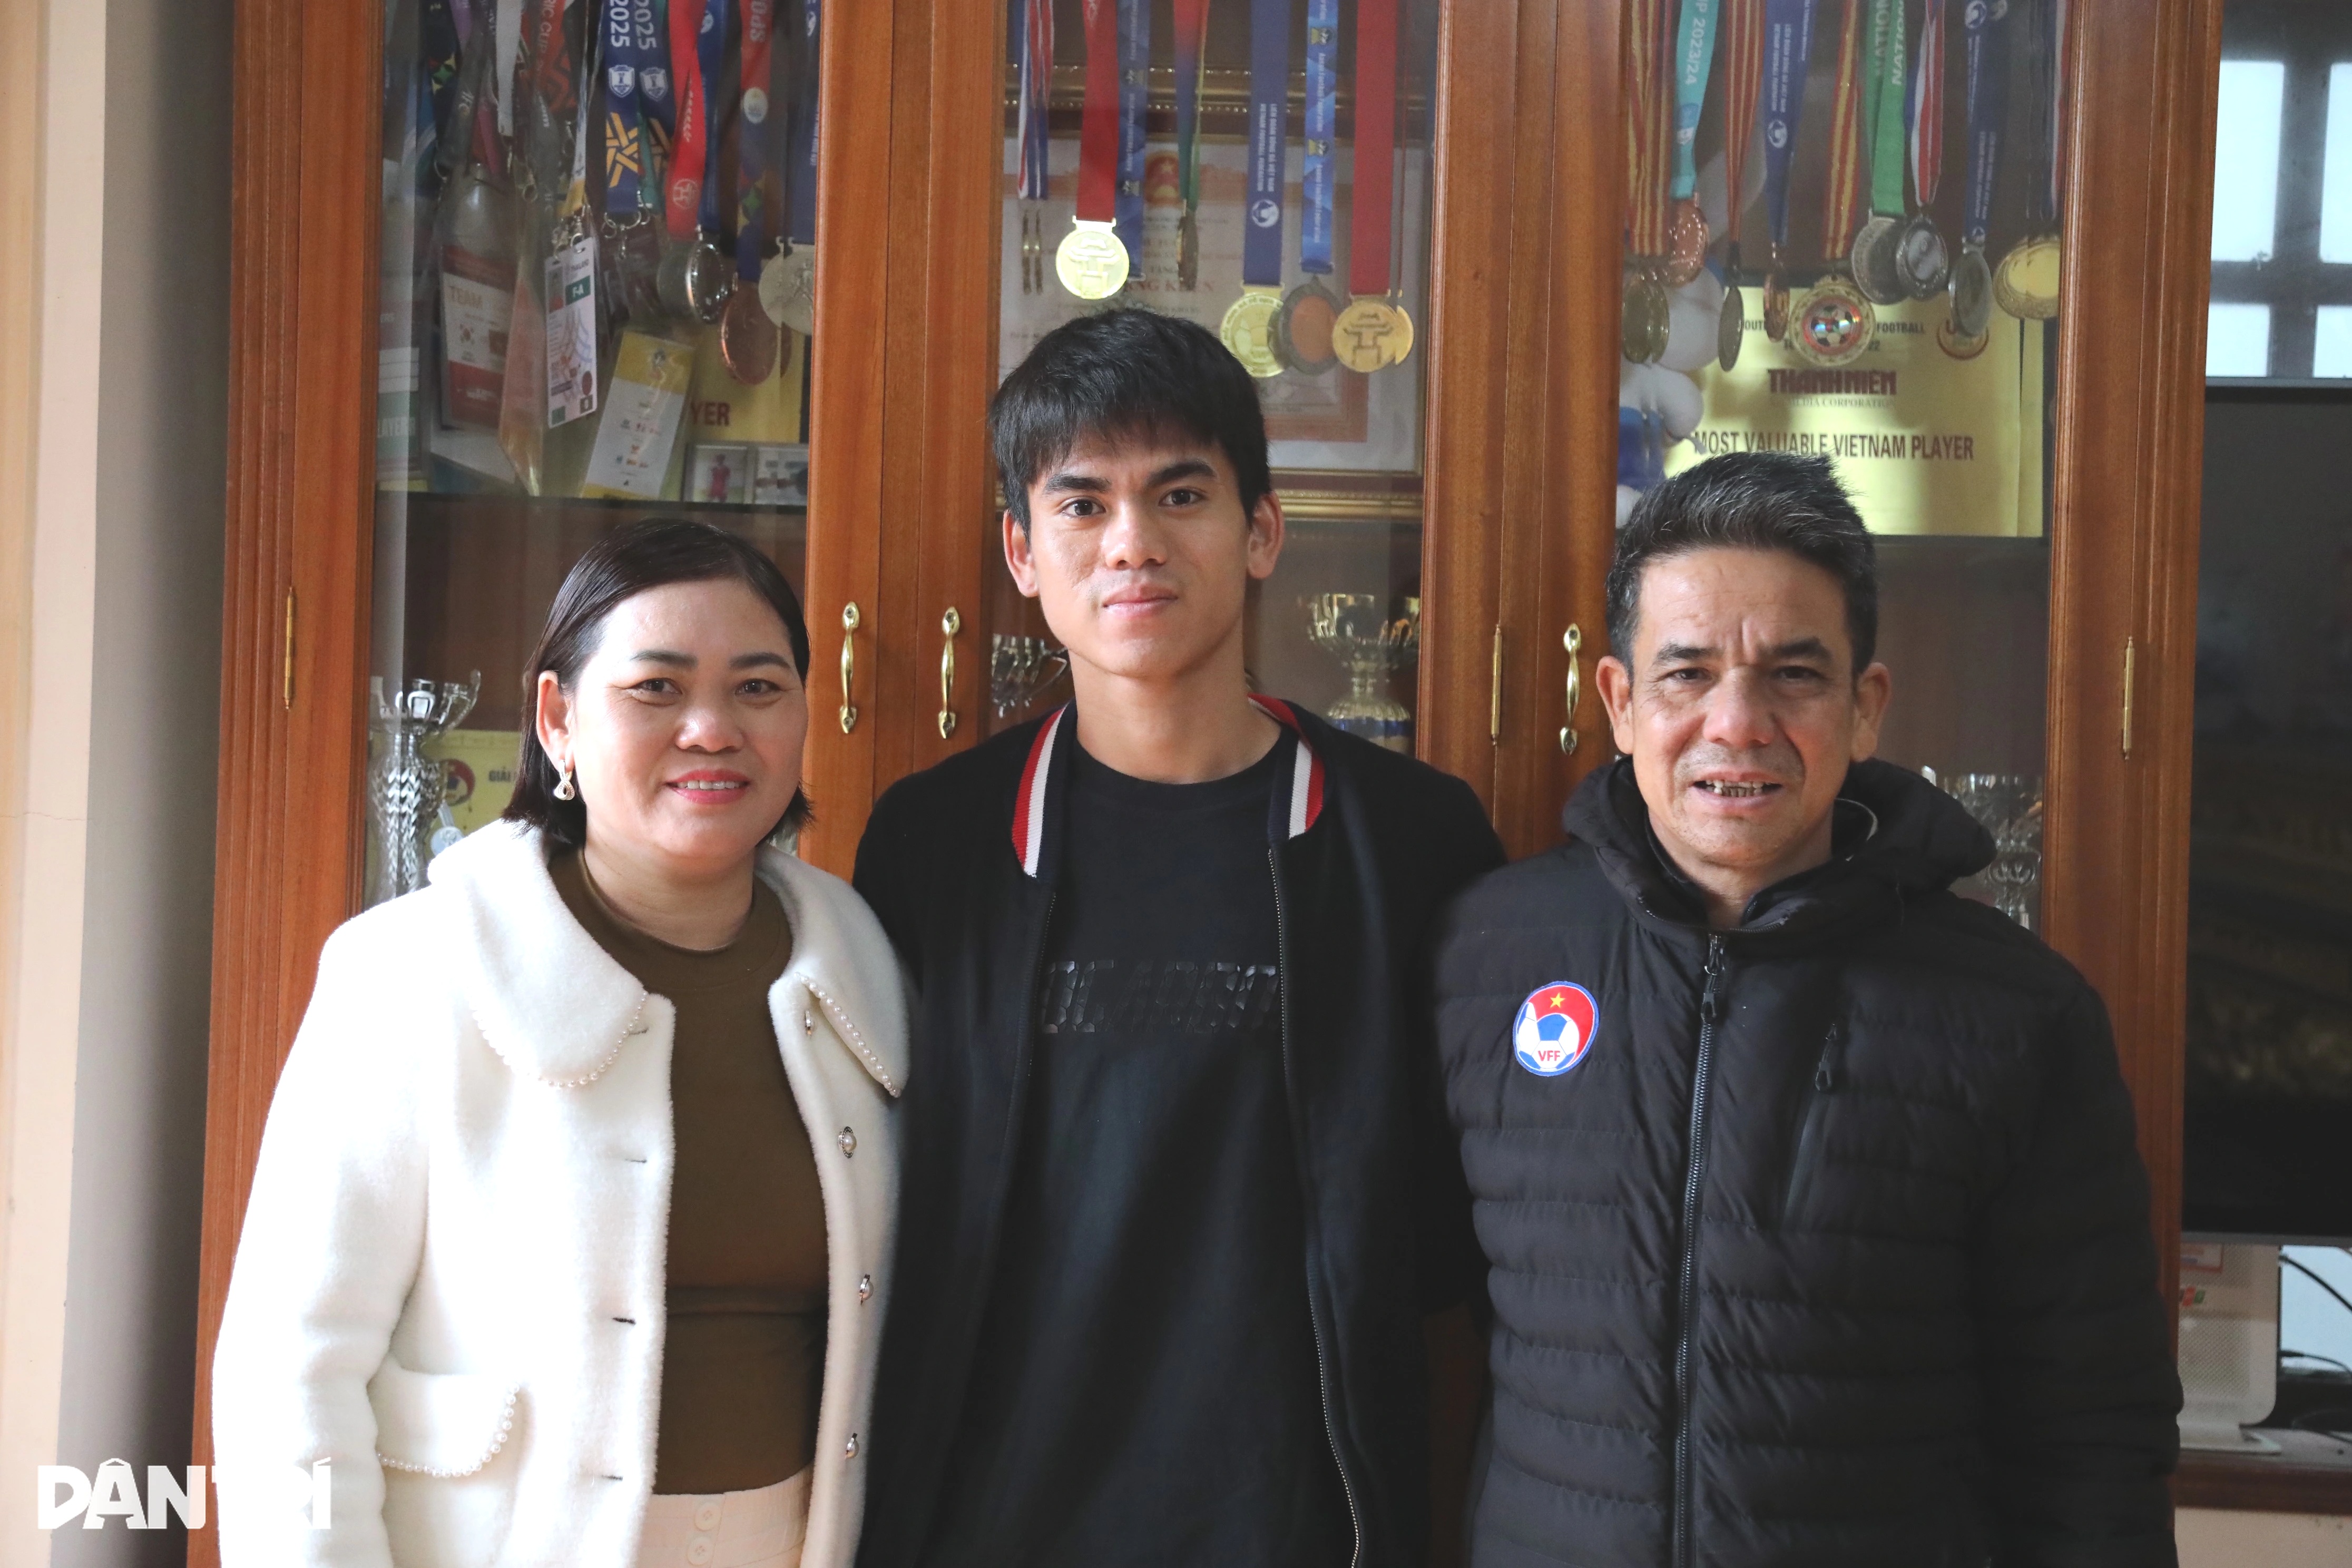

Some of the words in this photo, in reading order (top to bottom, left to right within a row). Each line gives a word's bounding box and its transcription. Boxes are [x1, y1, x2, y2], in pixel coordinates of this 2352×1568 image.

[1684, 17, 1706, 85] 2023/24
[1876, 322, 1926, 335] FOOTBALL
[690, 401, 731, 426] YER
[1694, 431, 1740, 454] MOST
[1745, 432, 1828, 456] VALUABLE
[1833, 434, 1906, 458] VIETNAM
[1911, 435, 1974, 460] PLAYER
[1537, 1050, 1561, 1062] VFF
